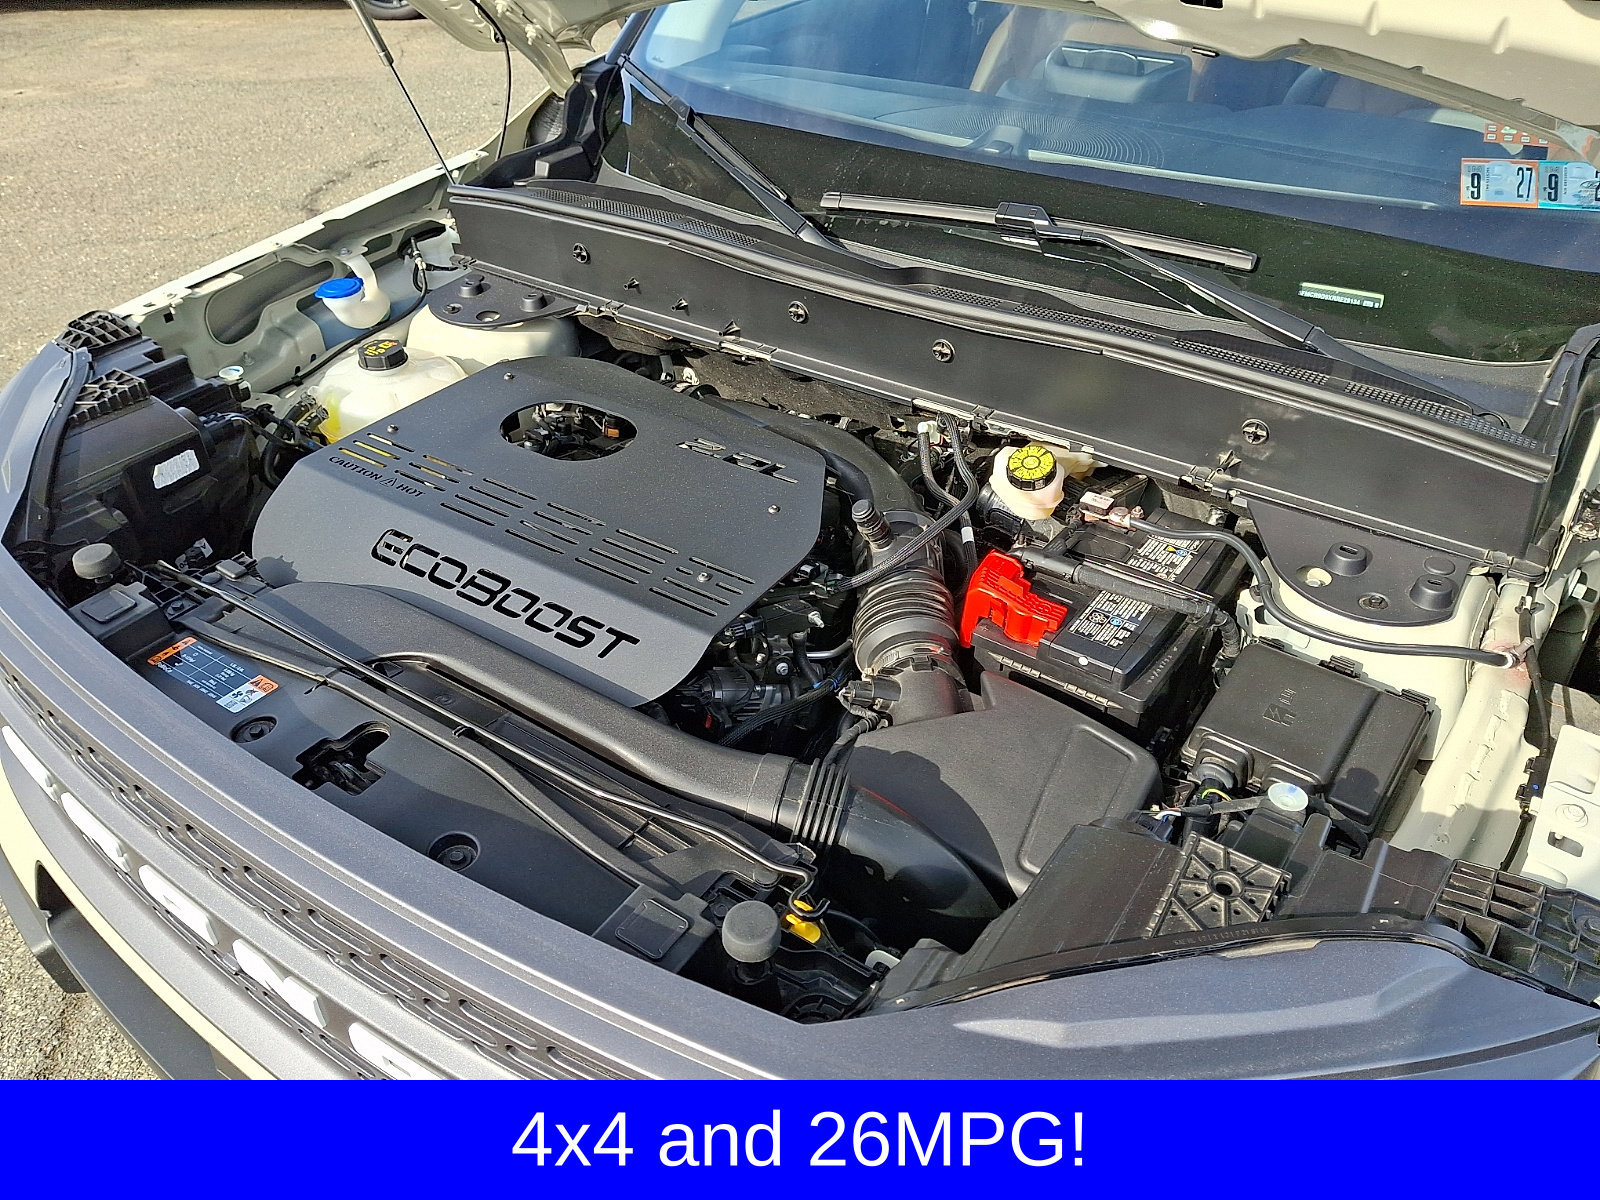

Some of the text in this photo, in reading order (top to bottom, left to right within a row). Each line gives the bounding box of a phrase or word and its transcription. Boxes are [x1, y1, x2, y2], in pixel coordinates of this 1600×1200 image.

[1470, 172, 1482, 200] 9
[1516, 167, 1533, 198] 27
[1547, 173, 1559, 202] 9
[328, 456, 426, 498] CAUTION HOT
[370, 528, 641, 659] ECOBOOST
